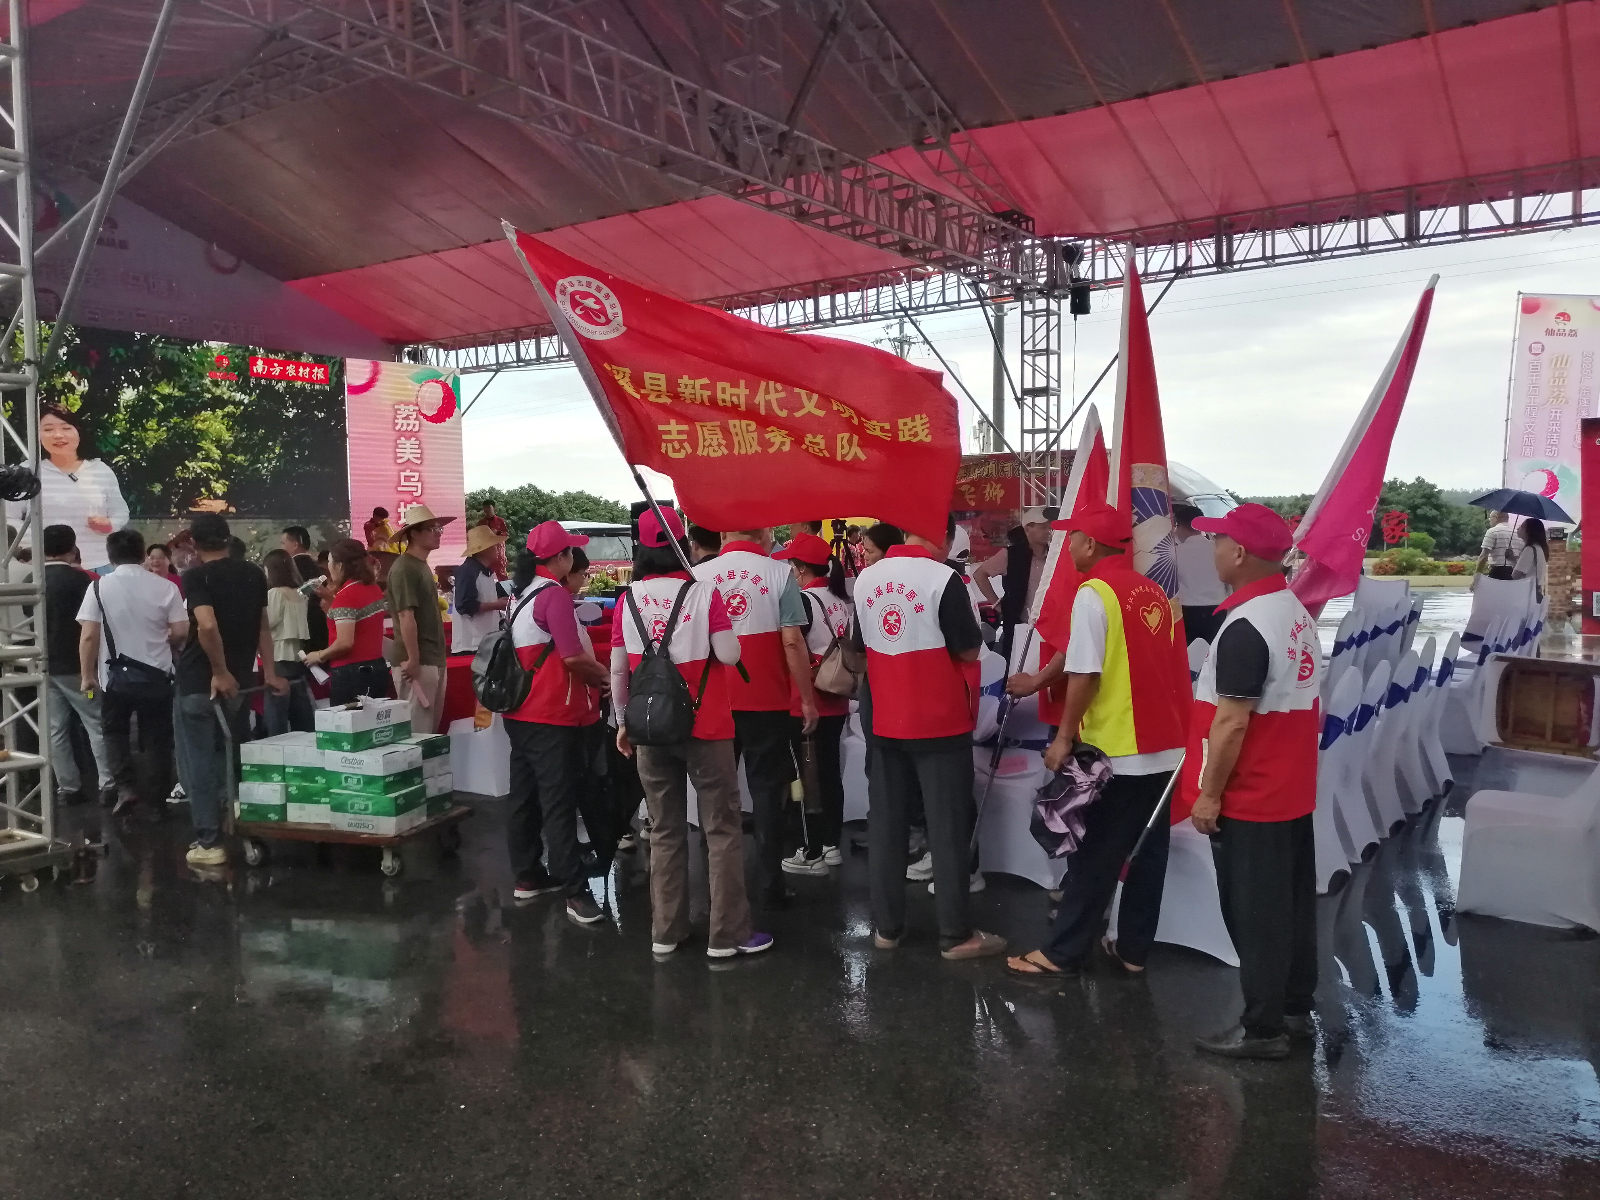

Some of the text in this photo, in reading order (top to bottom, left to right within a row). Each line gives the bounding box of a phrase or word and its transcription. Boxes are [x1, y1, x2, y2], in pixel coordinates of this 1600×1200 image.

[252, 359, 326, 381] 南方农村报
[657, 418, 867, 462] 志愿服务总队
